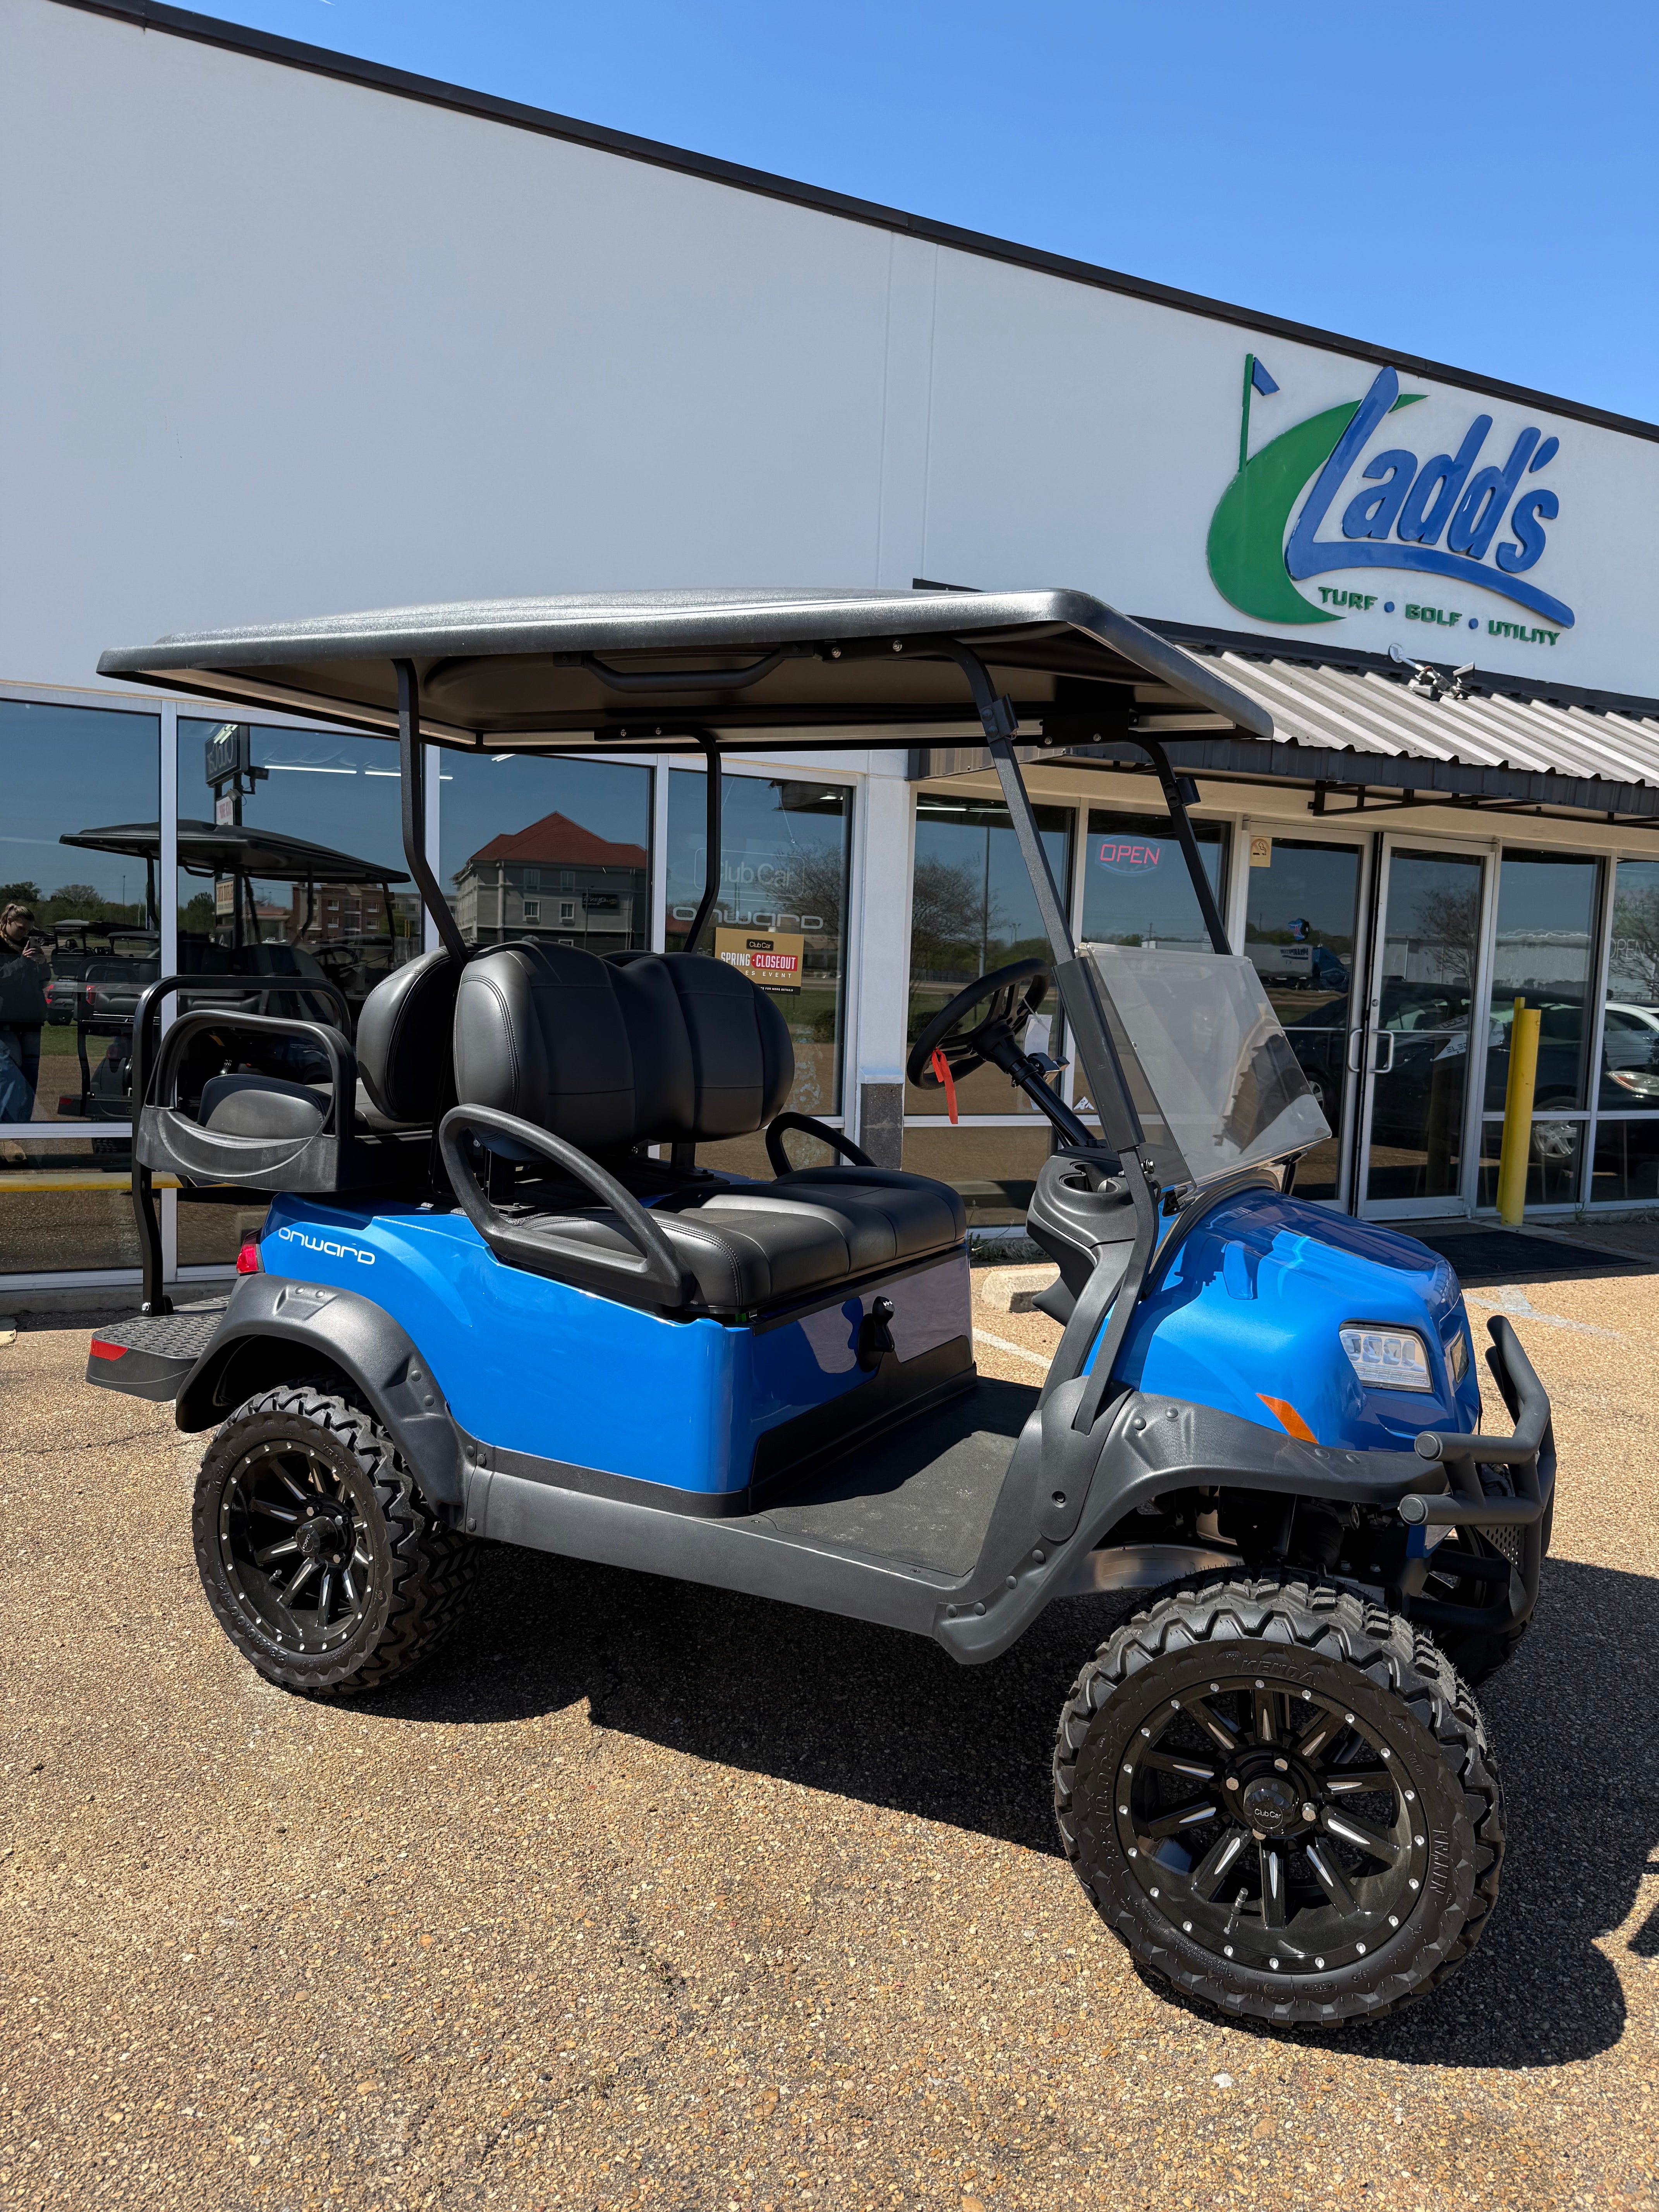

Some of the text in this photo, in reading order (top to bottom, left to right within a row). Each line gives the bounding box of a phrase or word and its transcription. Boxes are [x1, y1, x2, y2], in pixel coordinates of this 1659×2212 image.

[1284, 366, 1575, 629] Ladd's
[1318, 586, 1561, 647] TURF GOLF UTILITY
[1100, 844, 1160, 865] OPEN
[720, 860, 794, 889] lub Car
[721, 952, 796, 970] SPRING CLOSEOUT
[1241, 1660, 1314, 1685] KENDA
[1255, 1808, 1269, 1817] Club
[1430, 1829, 1449, 1894] KRAKEN
